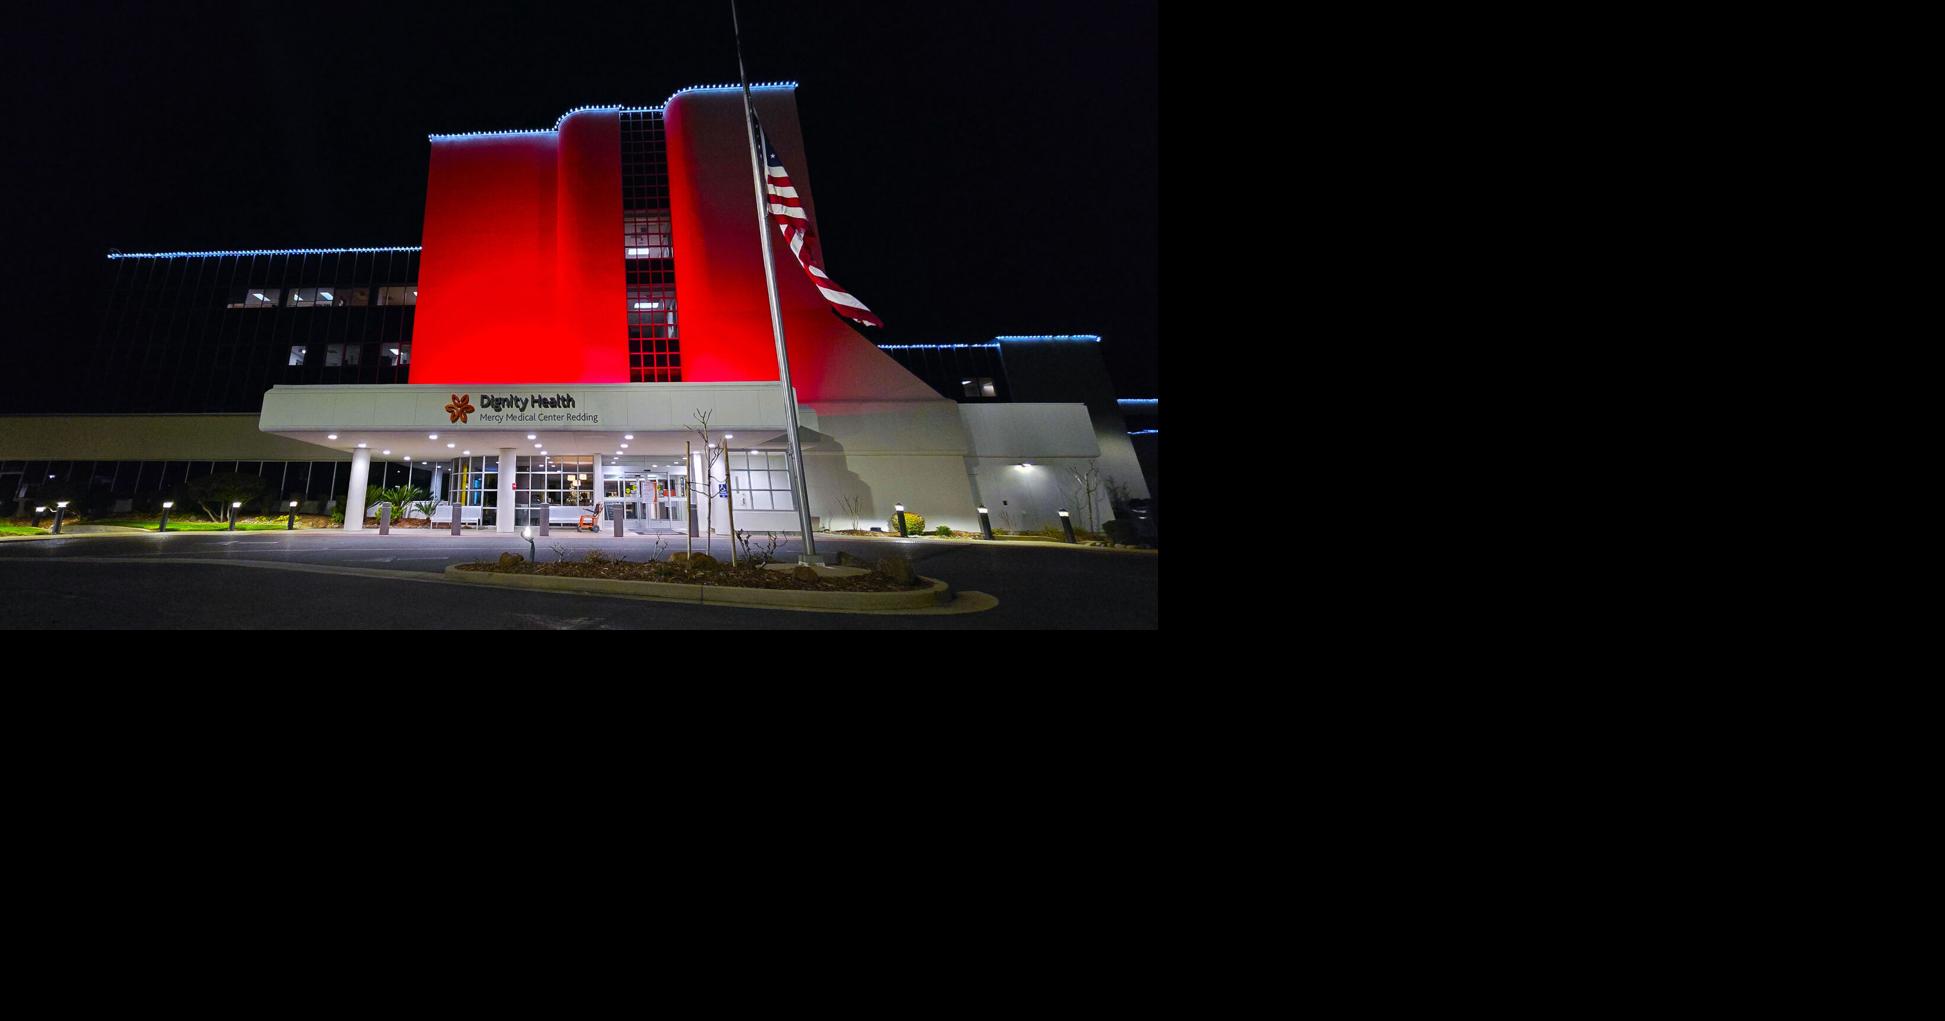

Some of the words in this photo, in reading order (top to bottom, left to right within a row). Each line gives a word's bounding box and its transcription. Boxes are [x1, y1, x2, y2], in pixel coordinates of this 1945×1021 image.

[480, 394, 529, 412] Dignity
[531, 393, 575, 408] Health
[480, 413, 503, 423] Mercy
[506, 413, 536, 421] Medical
[538, 413, 564, 421] Center
[566, 413, 598, 423] Redding
